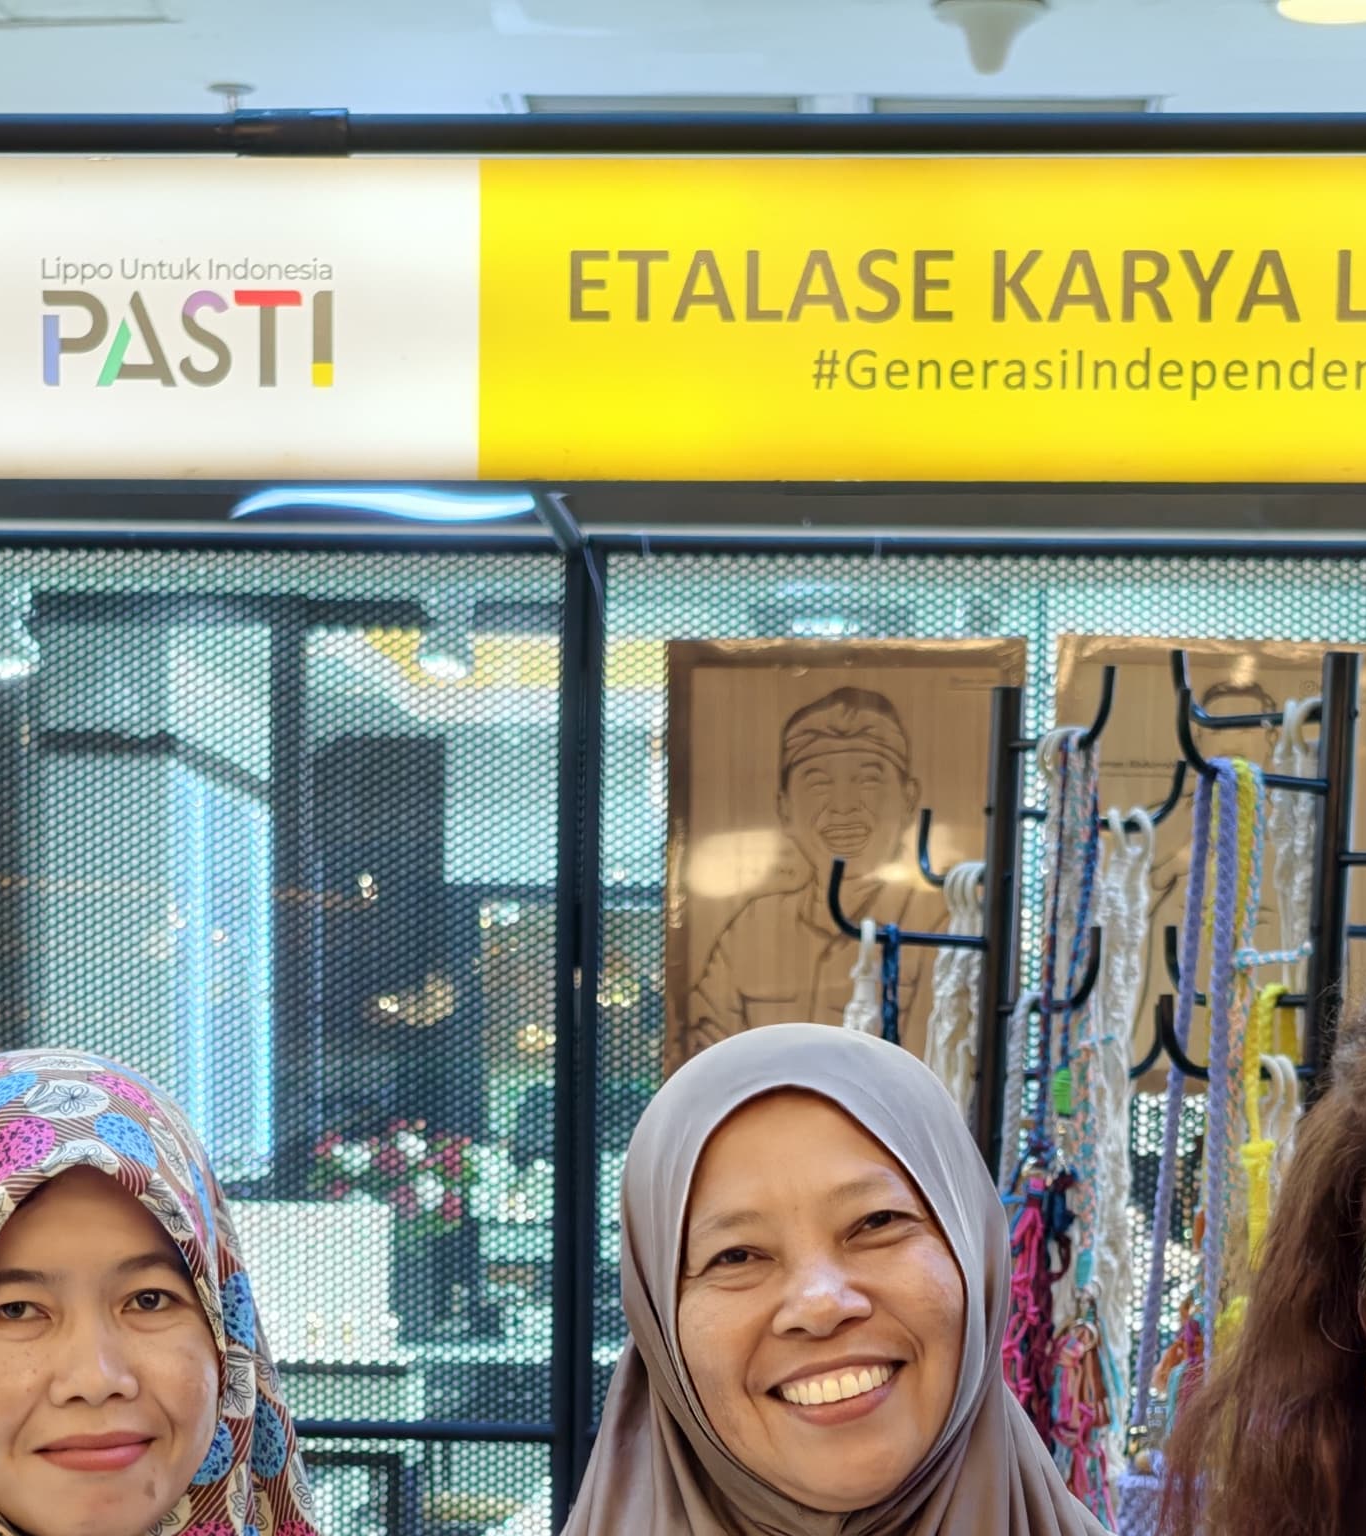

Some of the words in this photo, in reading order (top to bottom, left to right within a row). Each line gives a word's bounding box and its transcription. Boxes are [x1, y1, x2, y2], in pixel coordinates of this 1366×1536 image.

[41, 257, 113, 285] Lippo
[120, 257, 201, 281] Untuk
[209, 257, 332, 281] Indonesia
[569, 249, 954, 323] ETALASE
[992, 249, 1301, 323] KARYA
[42, 290, 335, 388] PASTI
